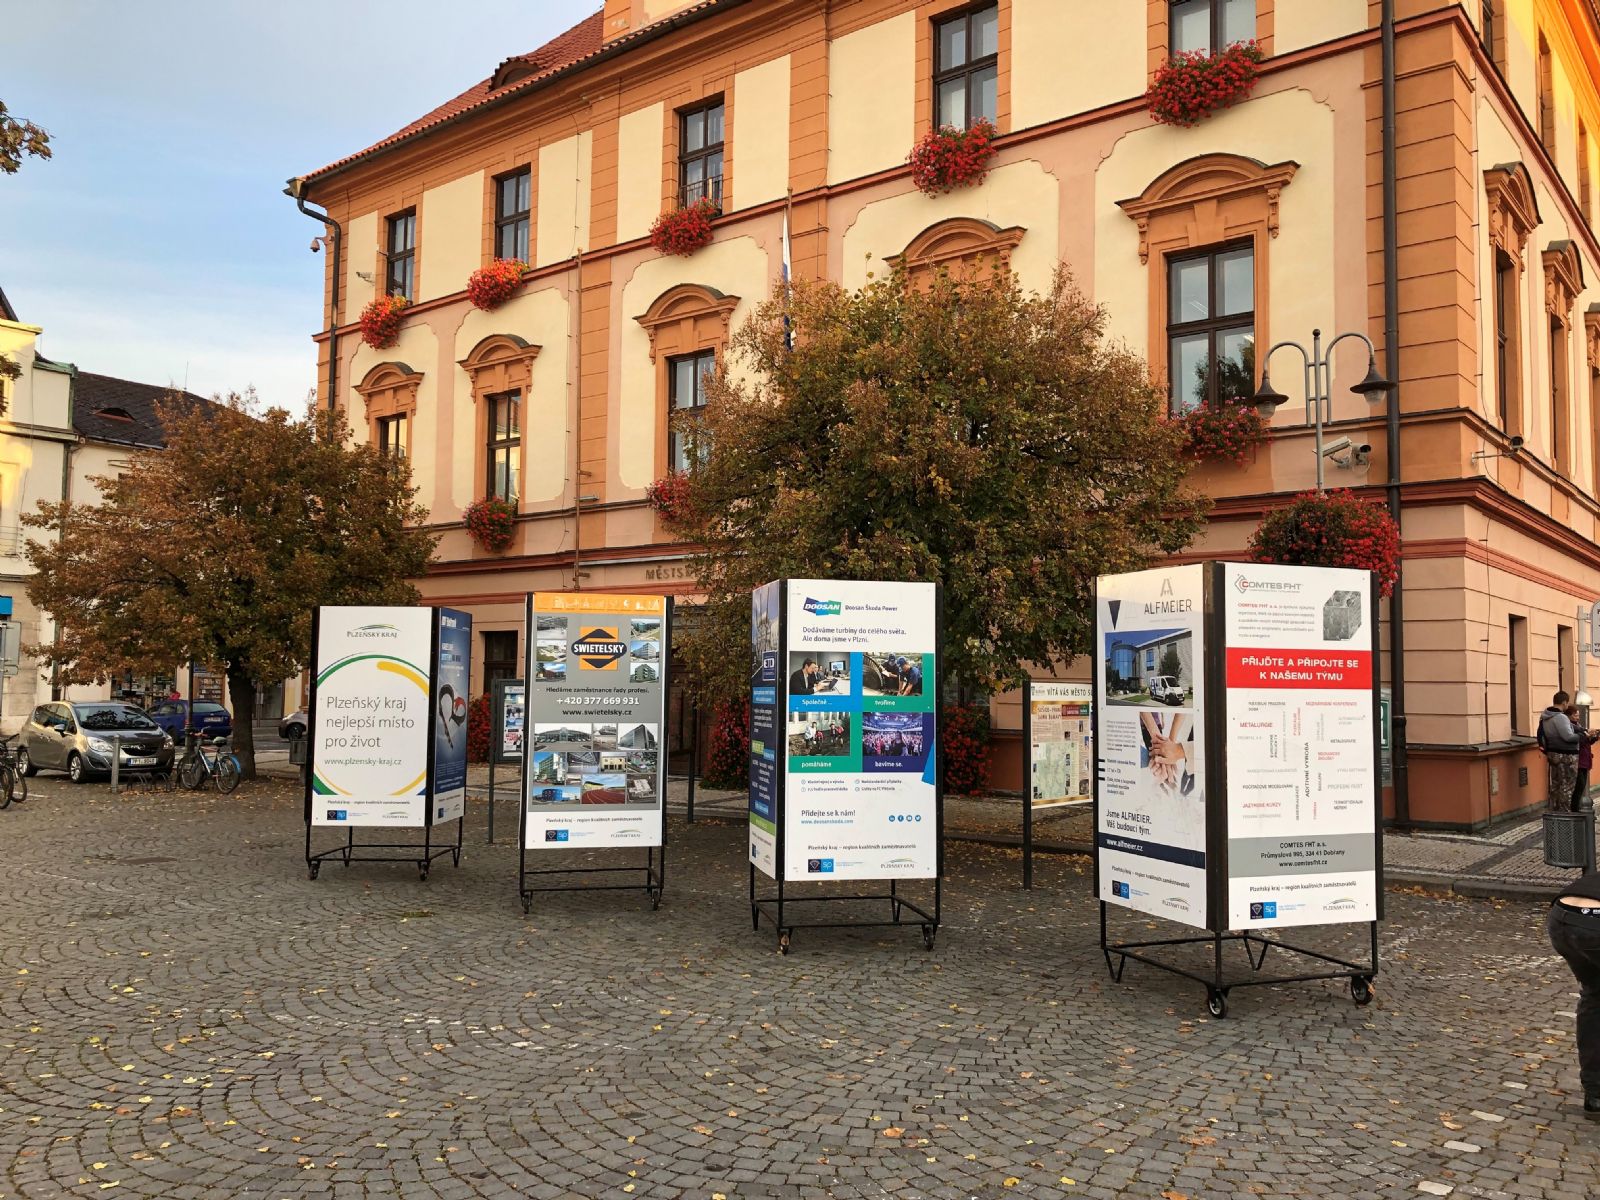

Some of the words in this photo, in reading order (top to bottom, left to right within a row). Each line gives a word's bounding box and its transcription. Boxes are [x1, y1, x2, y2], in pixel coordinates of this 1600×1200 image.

[1242, 581, 1282, 589] COMTES
[1283, 582, 1301, 590] FHT
[1144, 599, 1192, 615] ALFMEIER
[346, 630, 380, 638] PLZEŇSKÝ
[573, 644, 624, 654] SWIETELSKY
[1242, 656, 1284, 666] PŘIJĎTE
[1287, 658, 1294, 666] A
[1297, 656, 1344, 668] PŘIPOJTE
[1346, 660, 1358, 668] SE
[1260, 671, 1266, 680] K
[1270, 670, 1312, 680] NAŠEMU
[1316, 670, 1343, 681] TÝMU
[1046, 686, 1058, 696] VÍTÁ
[1060, 687, 1068, 696] VÁS
[1070, 688, 1086, 696] MĚSTO
[327, 696, 381, 712] Plzeňský
[384, 696, 407, 712] kraj
[556, 697, 582, 705] +420
[584, 697, 602, 705] 377
[603, 697, 620, 705] 669
[622, 697, 640, 705] 931
[326, 715, 376, 731] nejlepší
[378, 715, 415, 728] místo
[325, 737, 348, 750] pro
[350, 735, 382, 748] život
[324, 757, 402, 767] www.plzensky-kraj.cz
[801, 810, 826, 818] Přidejte
[1106, 809, 1120, 819] Jsme
[1121, 812, 1152, 824] ALFMEIER.
[1106, 820, 1115, 828] Váš
[1117, 822, 1138, 832] budoucí
[1139, 826, 1151, 836] tým.
[1106, 839, 1143, 851] www.alfmeier.cz
